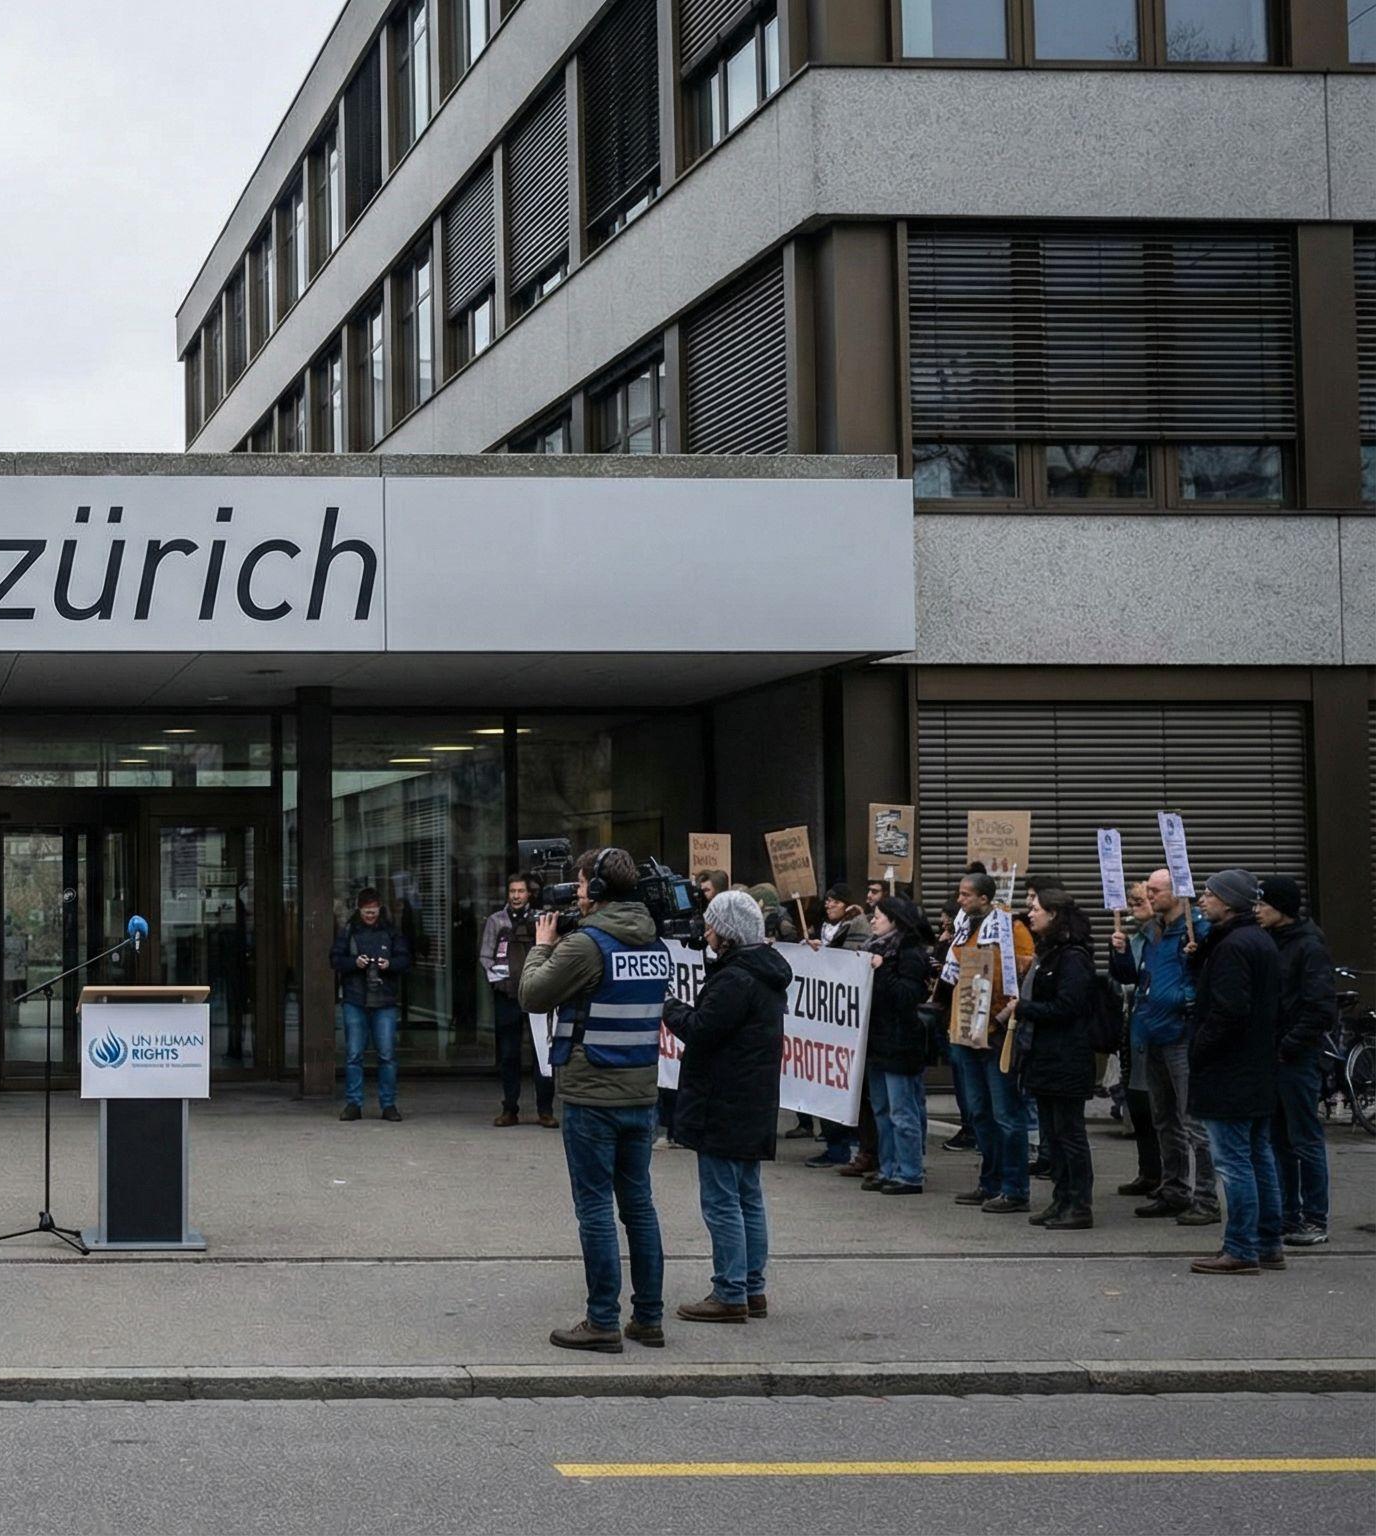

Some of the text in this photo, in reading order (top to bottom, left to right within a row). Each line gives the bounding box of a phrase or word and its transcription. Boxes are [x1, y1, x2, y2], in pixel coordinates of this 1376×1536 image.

[615, 954, 668, 979] PRESS
[794, 975, 860, 1029] ZURICH
[131, 1035, 152, 1047] UN
[132, 1048, 179, 1061] RIGHTS
